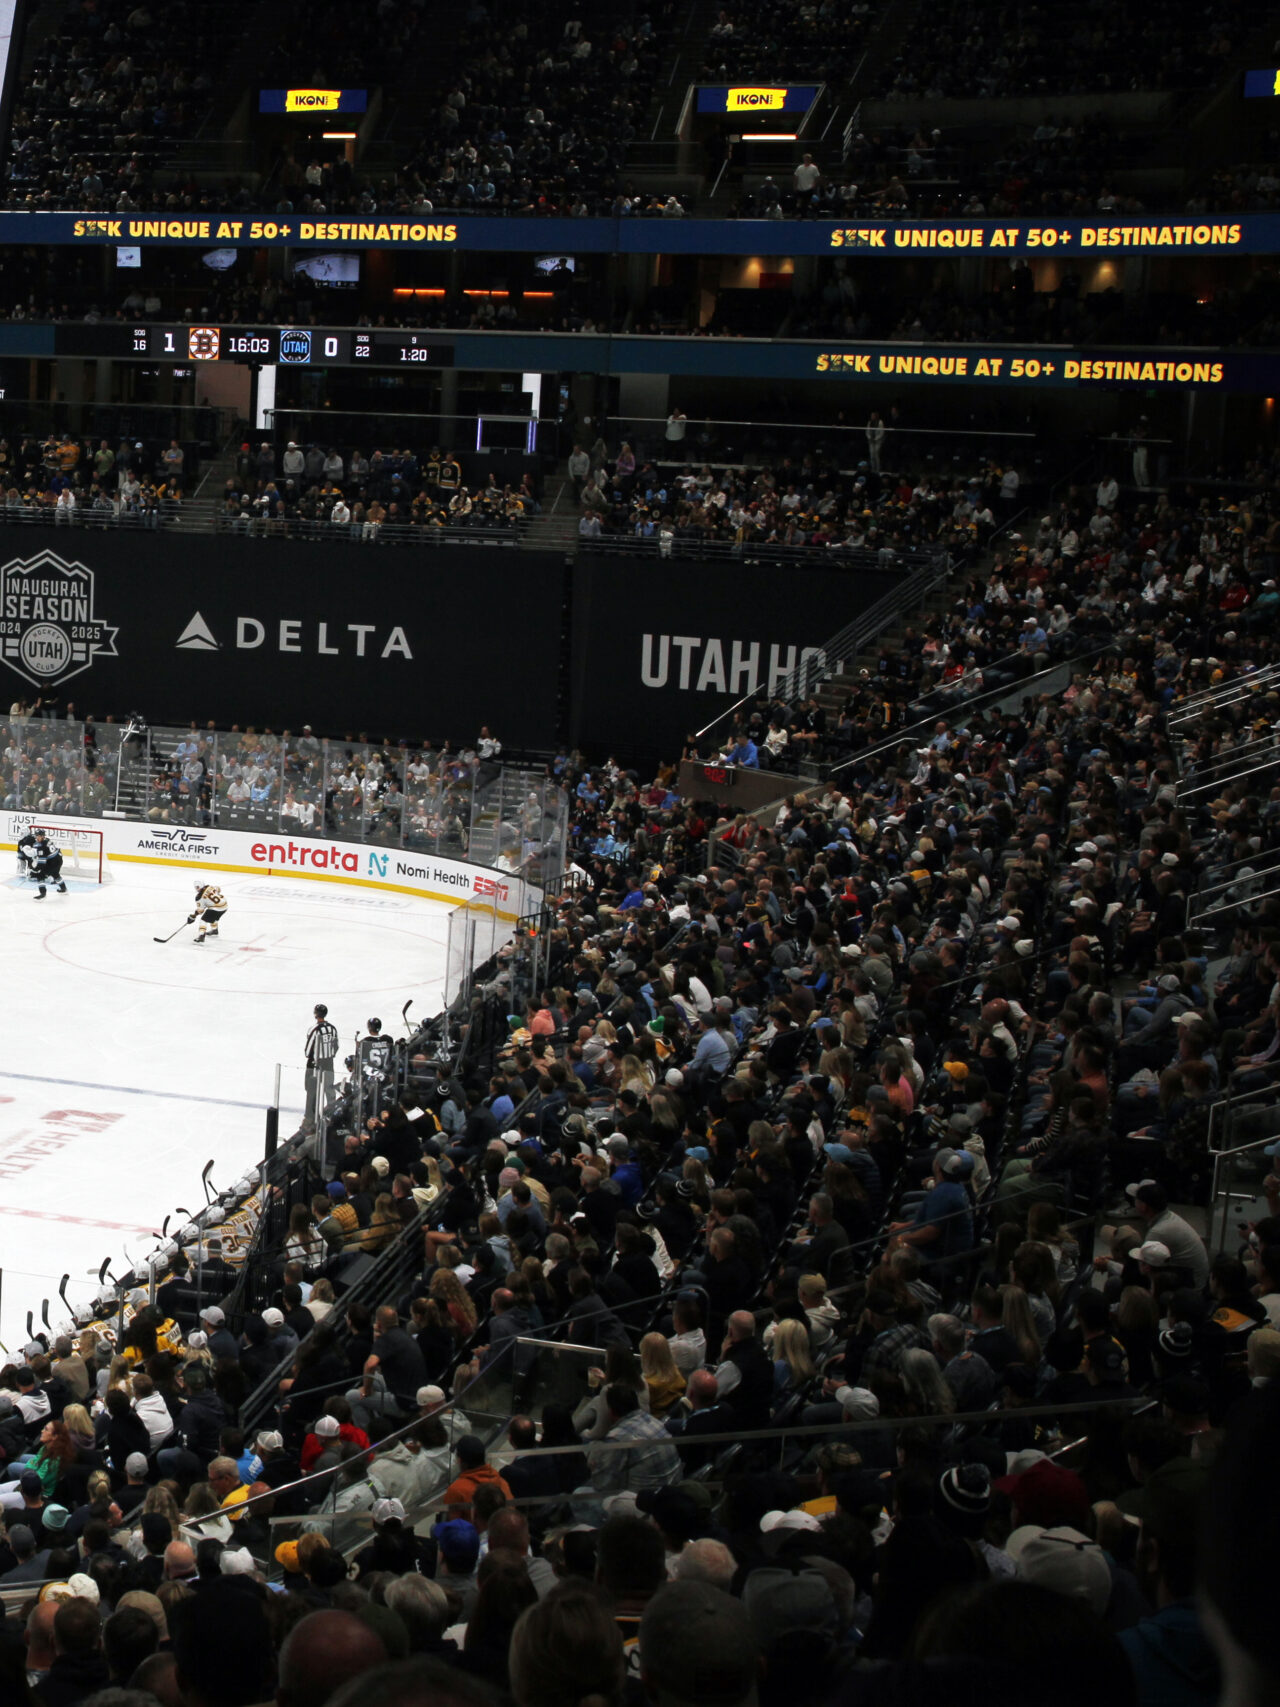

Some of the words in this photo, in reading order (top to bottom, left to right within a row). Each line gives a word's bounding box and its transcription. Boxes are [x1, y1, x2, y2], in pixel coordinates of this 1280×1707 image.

[295, 95, 325, 106] IKON
[736, 94, 770, 105] IKON
[129, 220, 210, 240] UNIQUE
[217, 222, 242, 238] AT
[250, 223, 291, 239] 50+
[299, 223, 457, 242] DESTINATIONS
[894, 228, 982, 248] UNIQUE
[990, 228, 1018, 247] AT
[1026, 228, 1072, 247] 50+
[1080, 224, 1241, 248] DESTINATIONS
[134, 328, 146, 337] SOG
[133, 339, 146, 351] 16
[164, 333, 175, 352] 1
[229, 337, 270, 353] 16:03
[283, 340, 308, 354] UTAH
[324, 337, 338, 357] 0
[355, 345, 370, 358] 22
[400, 348, 428, 362] 1:20
[879, 355, 967, 377] UNIQUE
[974, 358, 1002, 376] AT
[1010, 359, 1055, 378] 50+
[1063, 360, 1223, 383] DESTINATIONS
[6, 577, 88, 598] INAUGURAL
[6, 595, 88, 623] SEASON
[32, 628, 61, 640] HOCKEY
[71, 626, 100, 639] 2025
[236, 616, 414, 662] DELTA
[28, 641, 63, 660] UTAH
[35, 662, 56, 670] CLUB
[641, 633, 760, 697] UTAH
[12, 815, 37, 825] JUST
[137, 839, 186, 852] AMERICA
[188, 844, 220, 856] FIRST
[251, 841, 359, 873] entrata
[396, 862, 430, 880] Nomi
[434, 868, 470, 889] Health
[473, 875, 510, 902] ESPN
[370, 1048, 391, 1067] 67
